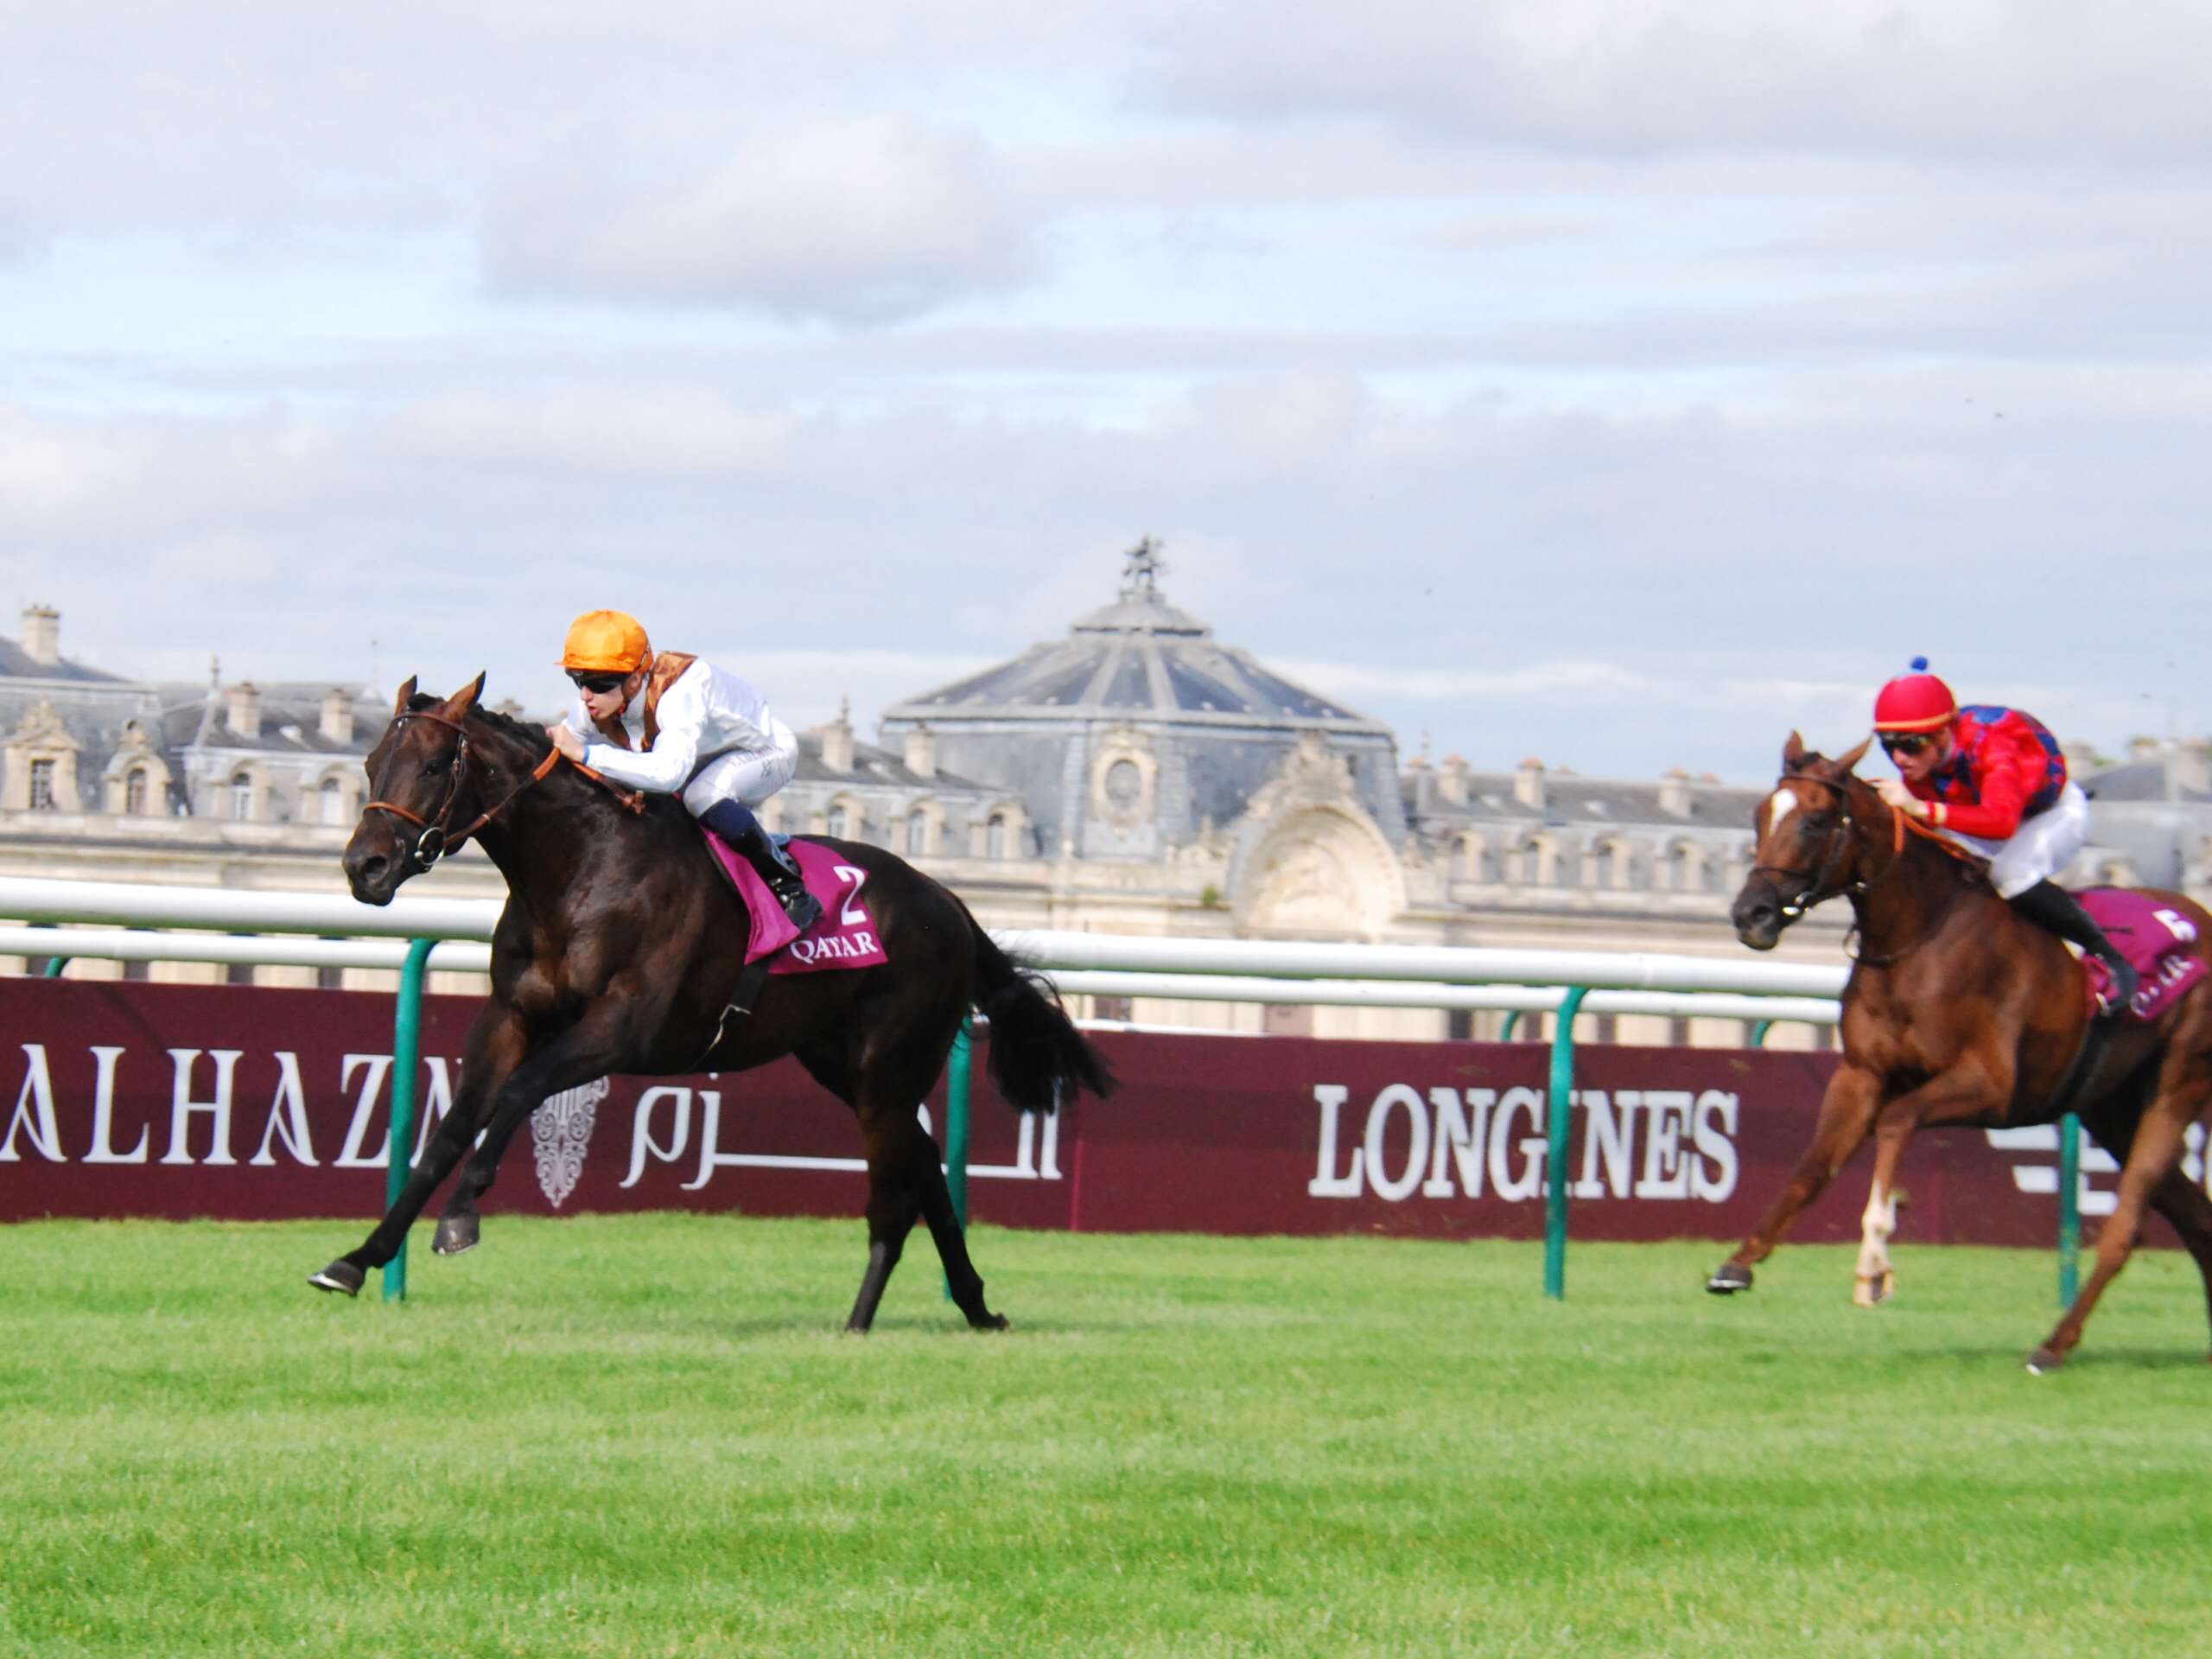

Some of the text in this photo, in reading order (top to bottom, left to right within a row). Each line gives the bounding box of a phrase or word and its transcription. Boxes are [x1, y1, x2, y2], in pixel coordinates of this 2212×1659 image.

[833, 866, 867, 925] 2
[790, 931, 879, 964] QATAR
[1307, 1084, 1739, 1202] LONGNES
